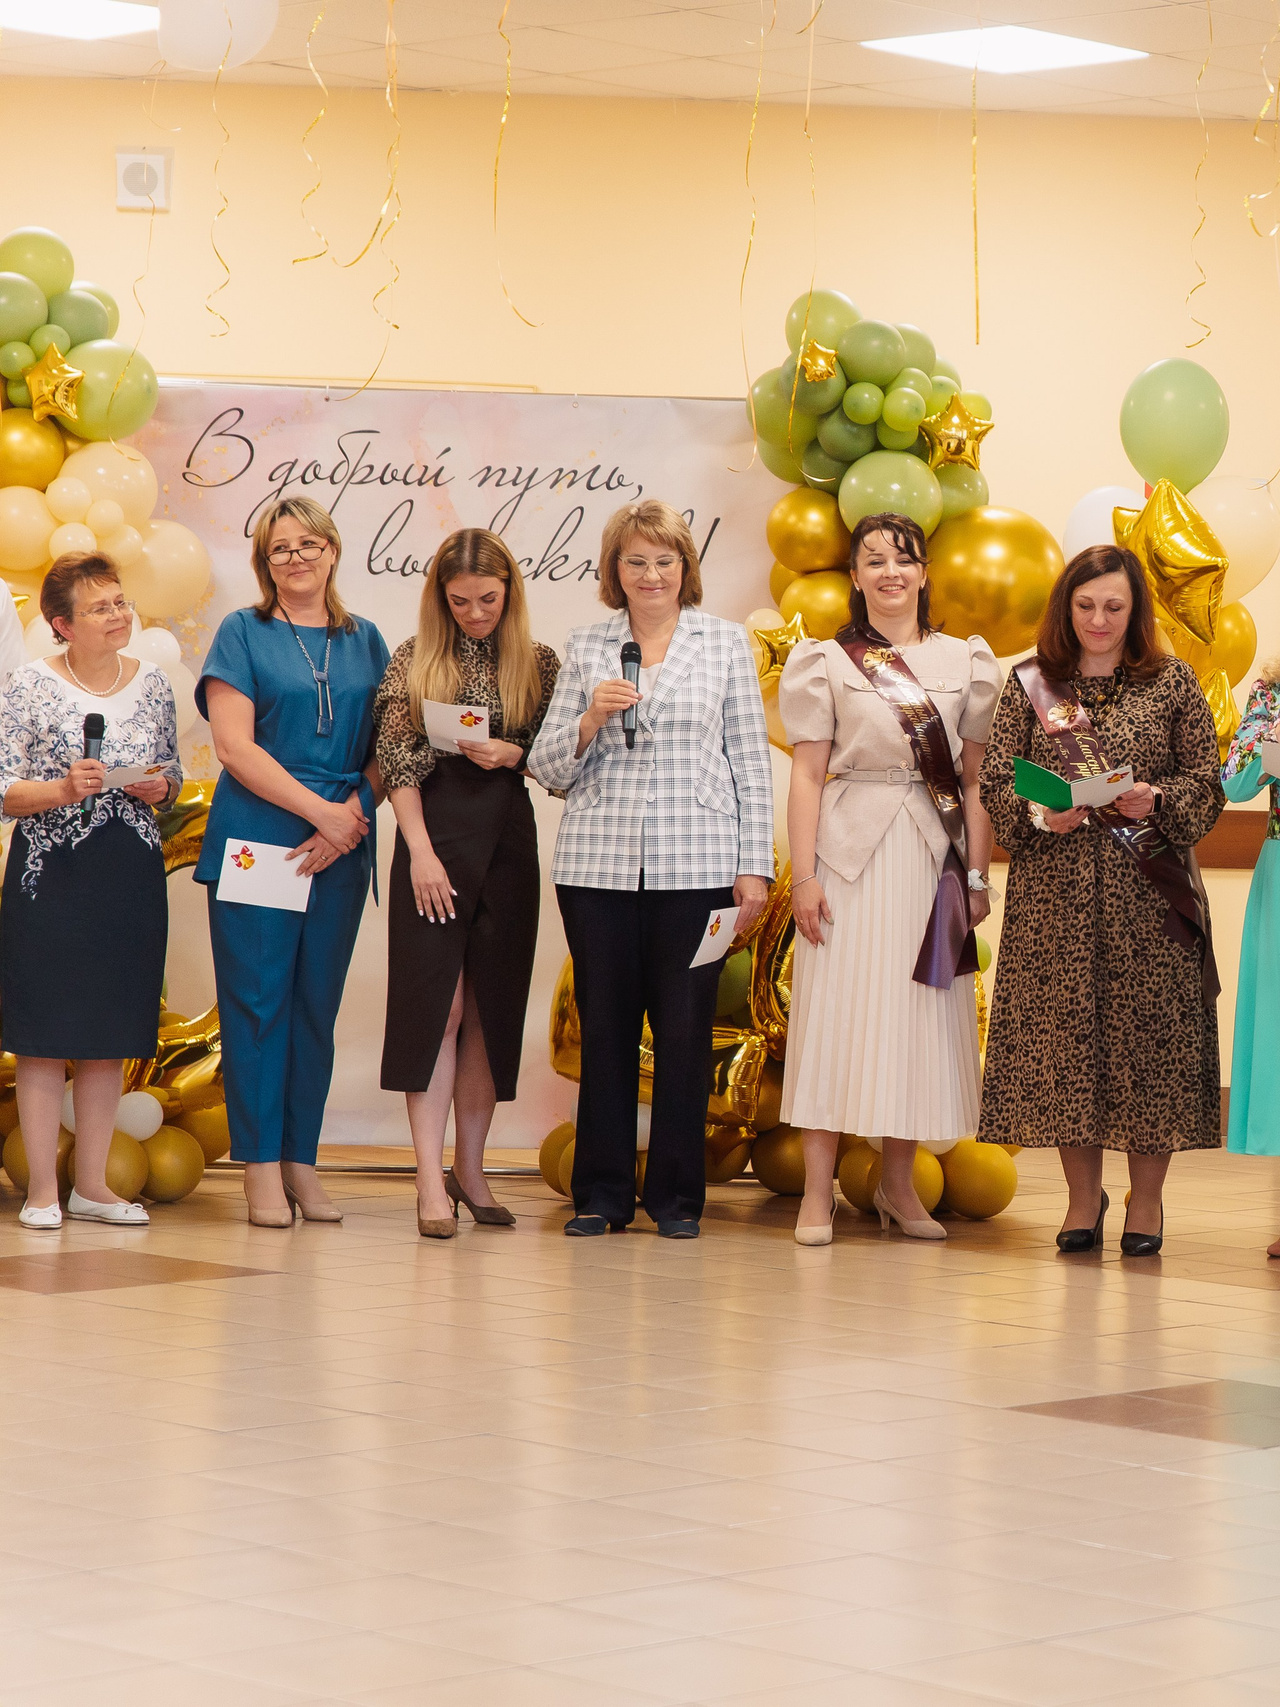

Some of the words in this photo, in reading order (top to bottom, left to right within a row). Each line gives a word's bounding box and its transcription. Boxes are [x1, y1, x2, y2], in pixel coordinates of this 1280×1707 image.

[181, 406, 255, 488] В
[243, 429, 456, 538] добрый
[468, 463, 644, 535] путь,
[1121, 818, 1169, 860] 2024
